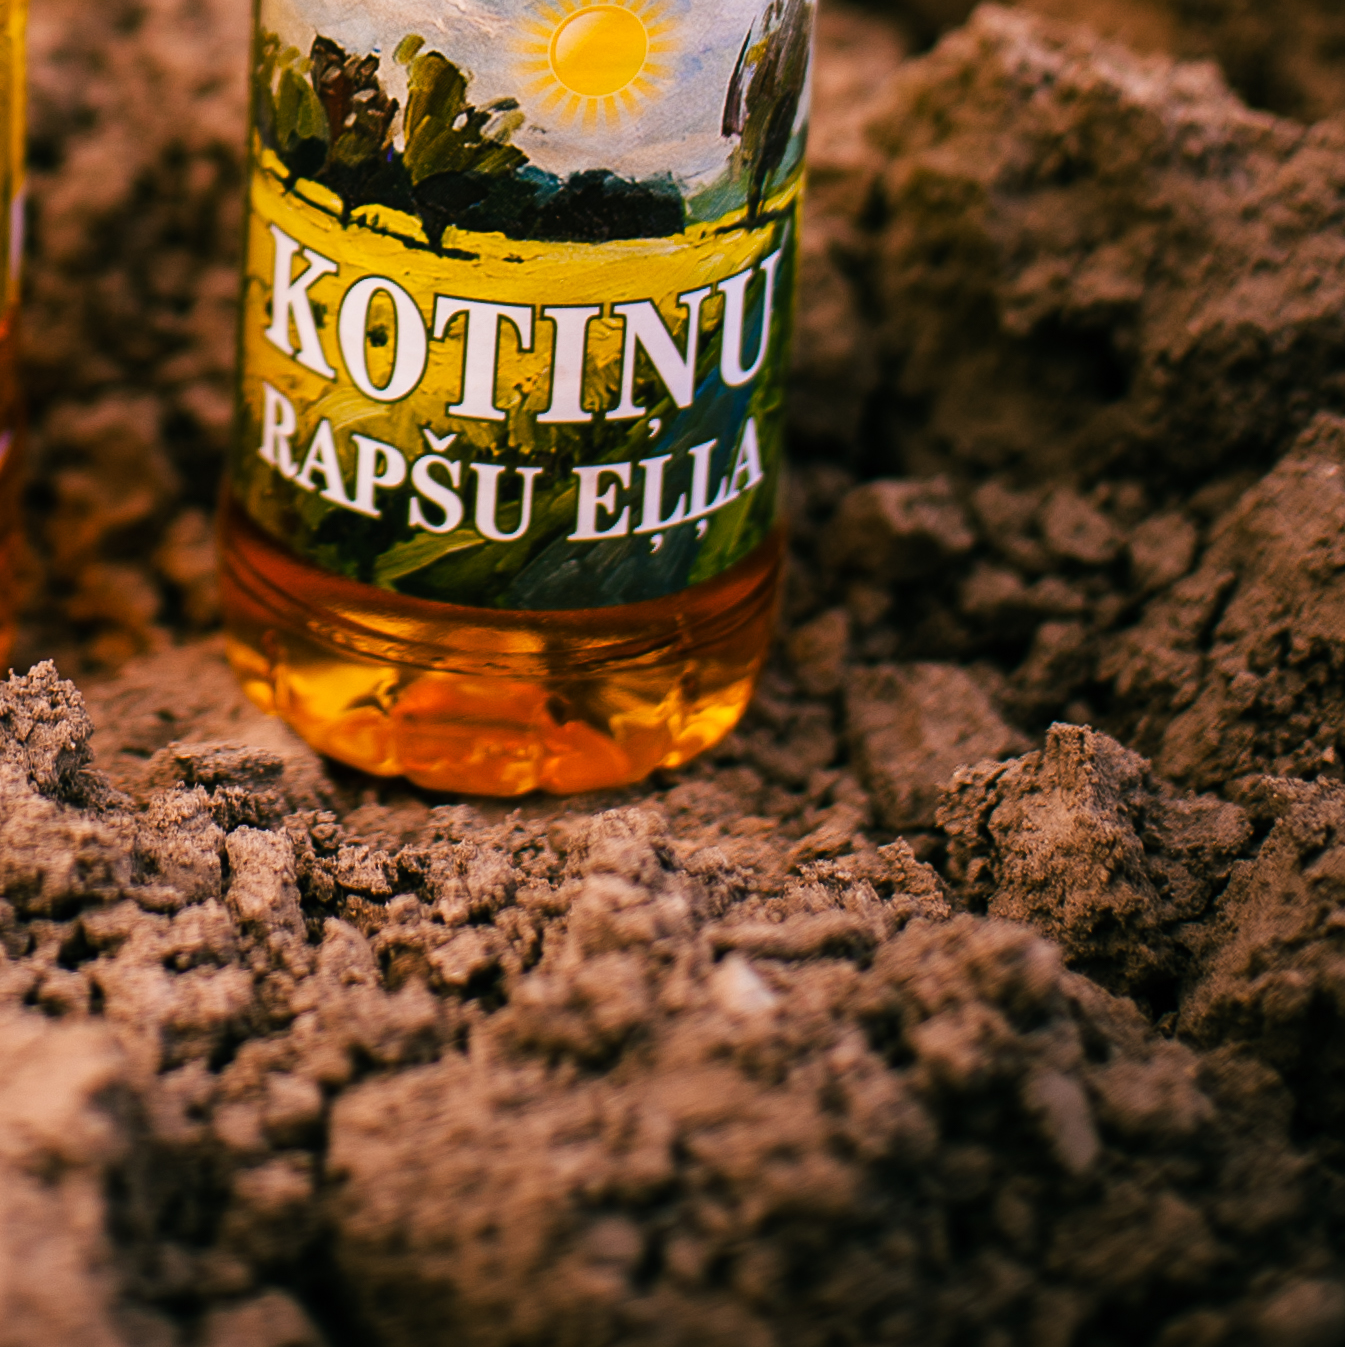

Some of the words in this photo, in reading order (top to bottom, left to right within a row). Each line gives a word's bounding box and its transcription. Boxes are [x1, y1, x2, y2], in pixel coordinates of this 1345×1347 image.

[263, 224, 782, 439] KOTIŅU
[258, 381, 543, 543] RAPŠU
[566, 417, 764, 554] EĻĻA
